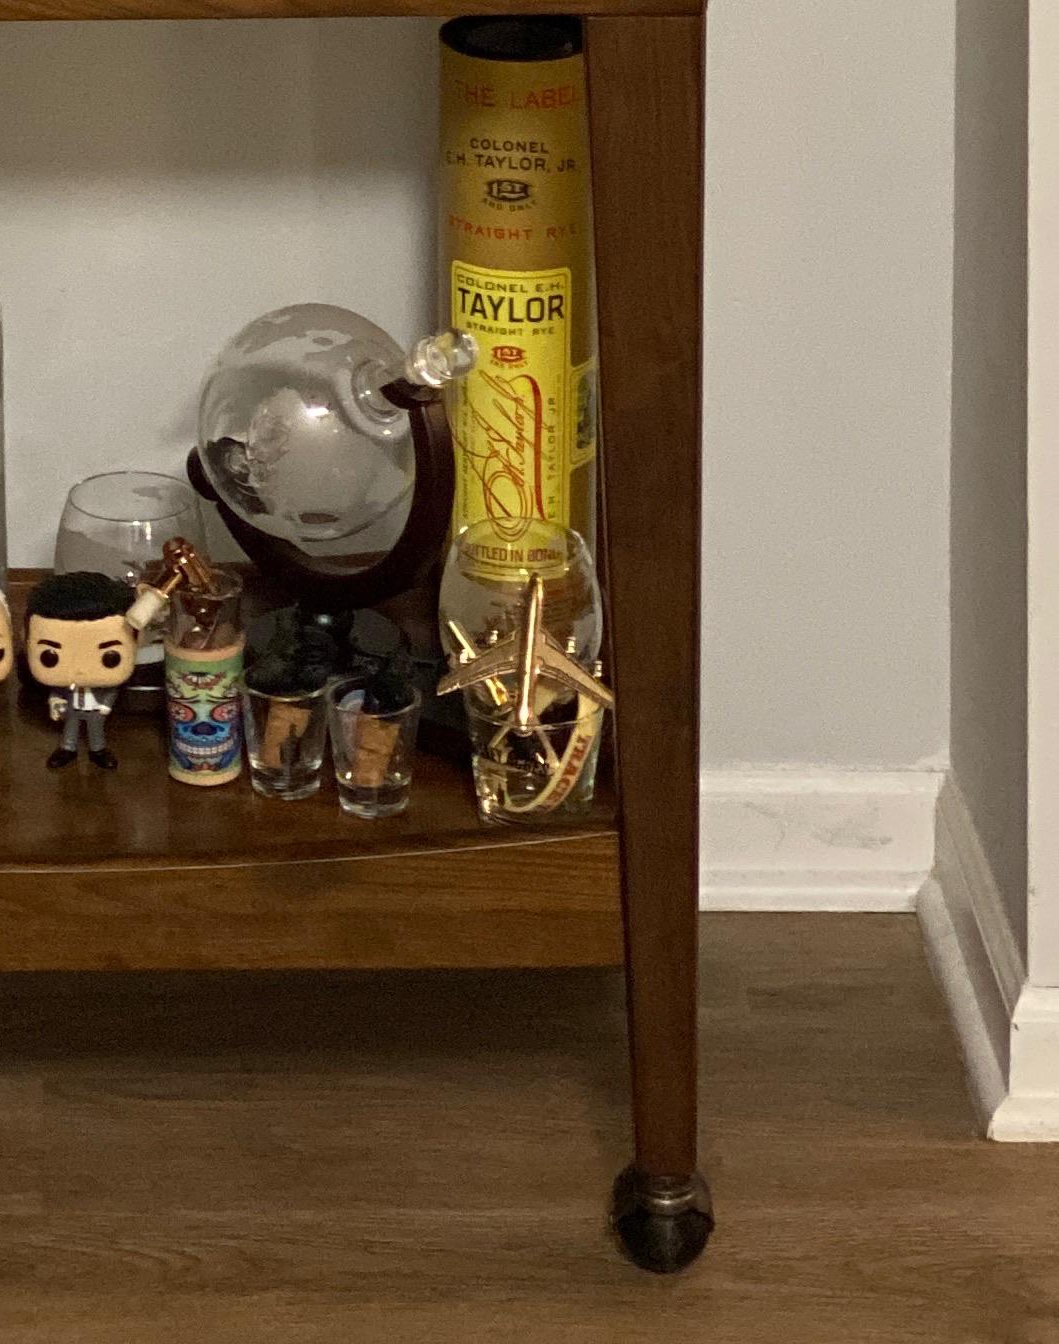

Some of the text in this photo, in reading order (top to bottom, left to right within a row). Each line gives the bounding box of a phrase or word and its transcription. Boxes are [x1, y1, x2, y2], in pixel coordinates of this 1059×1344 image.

[469, 138, 549, 154] COLONEL
[456, 273, 528, 293] COLONEL
[458, 287, 564, 323] TAYLOR
[467, 321, 554, 337] STRAIGHT RYE
[510, 550, 523, 562] IN
